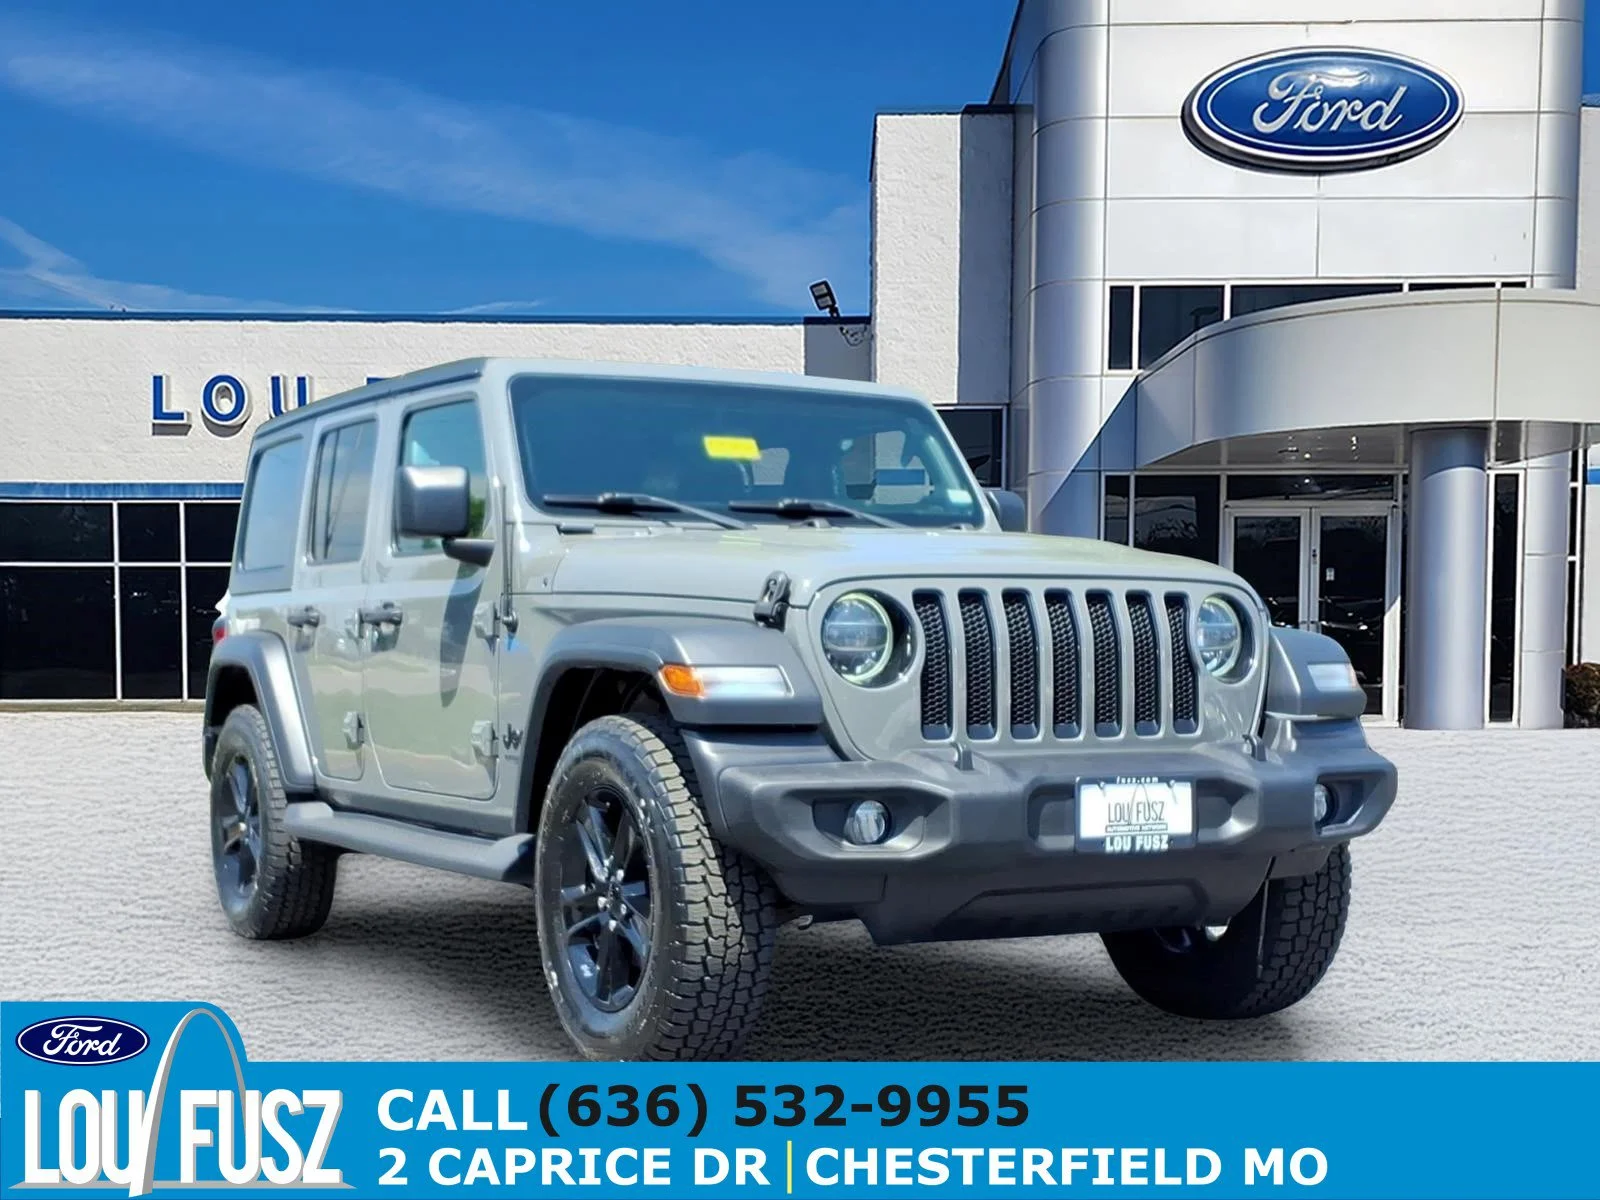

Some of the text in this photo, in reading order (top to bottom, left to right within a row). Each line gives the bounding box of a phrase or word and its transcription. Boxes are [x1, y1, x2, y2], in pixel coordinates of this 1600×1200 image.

[1252, 70, 1407, 133] Ford
[151, 374, 313, 421] LOU
[1108, 801, 1165, 824] LOU FUSZ
[1105, 834, 1169, 853] LOU FUSZ
